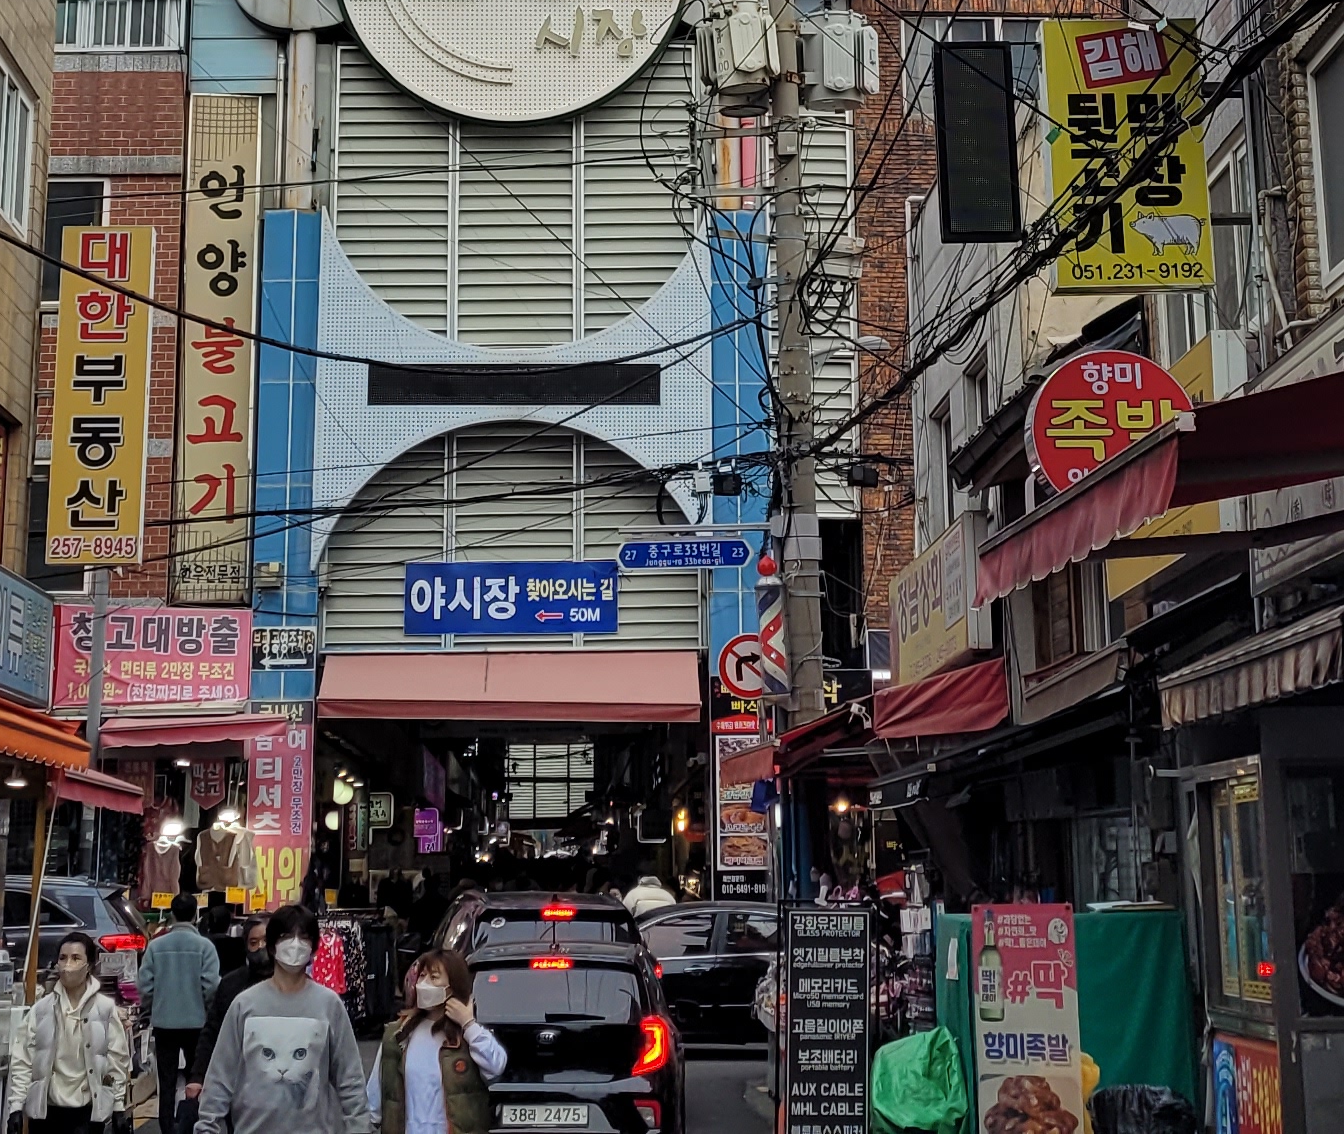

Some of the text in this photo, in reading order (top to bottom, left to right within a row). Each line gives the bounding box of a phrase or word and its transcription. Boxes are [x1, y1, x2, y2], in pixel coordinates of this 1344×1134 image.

[535, 6, 648, 57] 시장
[1082, 31, 1162, 82] 김해
[1071, 263, 1205, 280] 051.231-9192
[185, 165, 246, 524] 언양불고기
[64, 231, 136, 530] 대한부동산
[1081, 361, 1142, 395] 향미
[50, 536, 137, 559] 257-8945
[624, 543, 744, 561] 27 중구로33번길 23
[179, 564, 241, 584] 한우전문점
[410, 576, 614, 619] 야시장 찾아오시는 길
[569, 608, 600, 622] 50M
[70, 612, 240, 656] 창고대방출
[120, 663, 157, 678] 면티류
[161, 663, 194, 679] 2만장
[198, 662, 235, 678] 무조건
[198, 684, 240, 701] 주세요)
[253, 757, 282, 835] 티셔츠
[793, 916, 864, 930] 강화유리필름
[799, 979, 858, 993] 메모리카드
[792, 1019, 864, 1034] 고음질이어폰
[983, 1031, 1069, 1062] 향미족발
[798, 1050, 857, 1064] 보조배터리
[792, 1083, 863, 1096] AUX CABLE
[509, 1108, 581, 1121] 38라 2475
[791, 1103, 863, 1116] MHL CABLE
